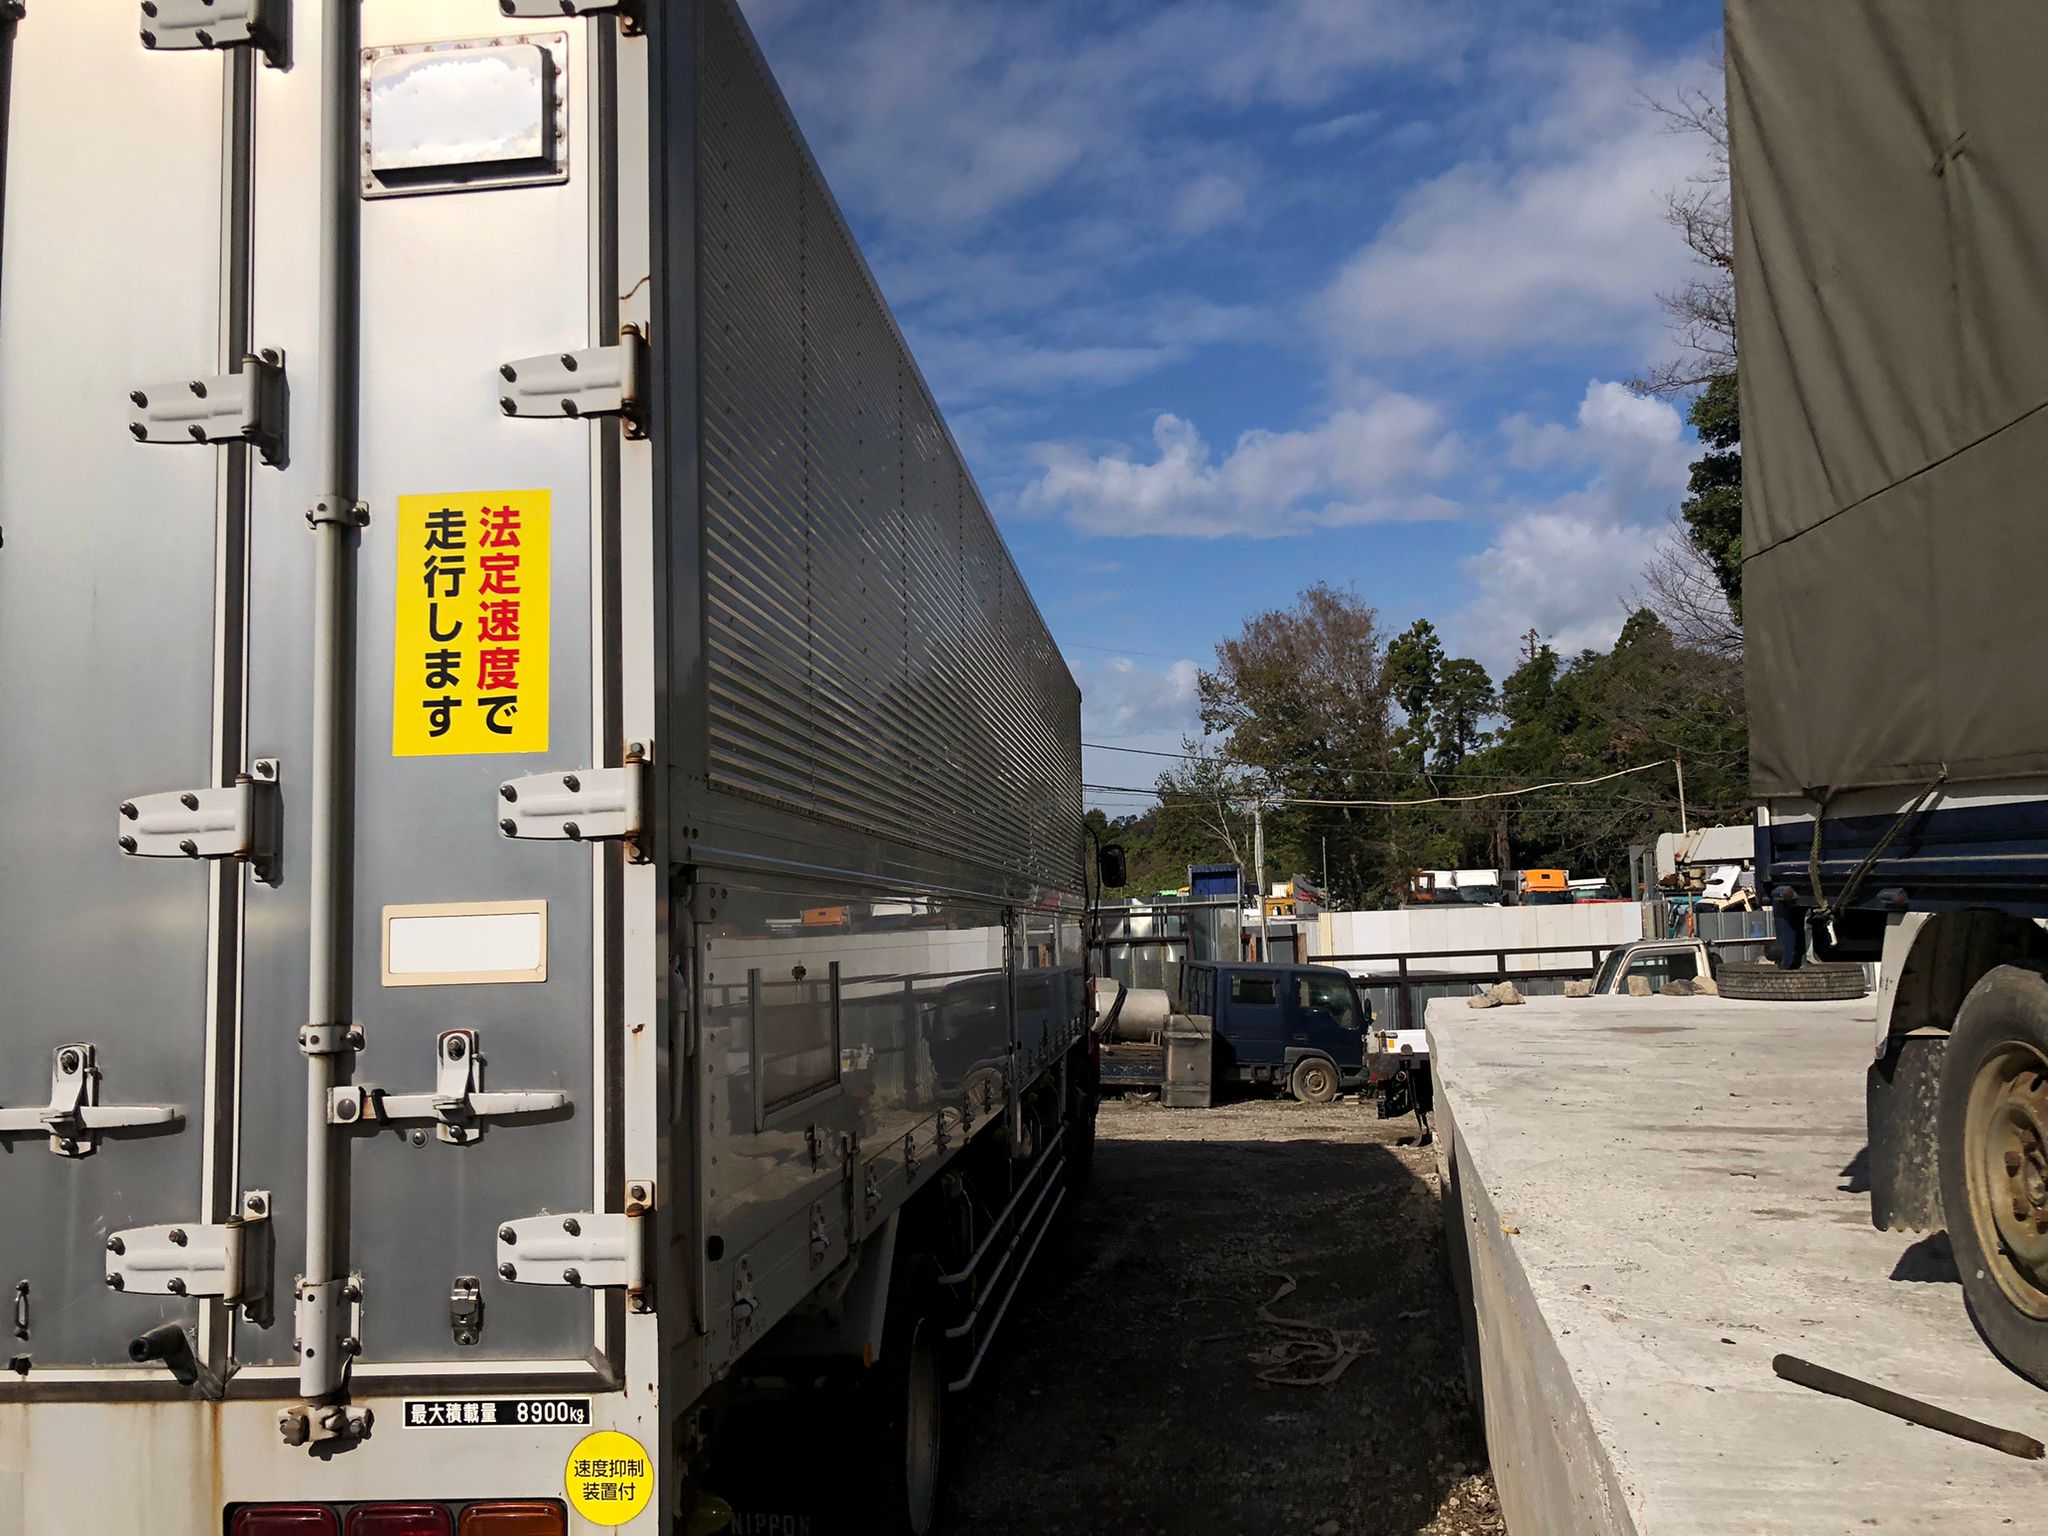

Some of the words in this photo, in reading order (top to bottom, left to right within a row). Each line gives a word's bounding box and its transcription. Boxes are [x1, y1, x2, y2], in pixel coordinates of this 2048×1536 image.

[423, 508, 467, 737] 走行します
[477, 505, 521, 735] 法定速度で
[411, 1403, 497, 1424] 最大積載量
[574, 1459, 644, 1478] 速度抑制
[583, 1482, 636, 1501] 装置付
[730, 1512, 812, 1536] NIPPON
